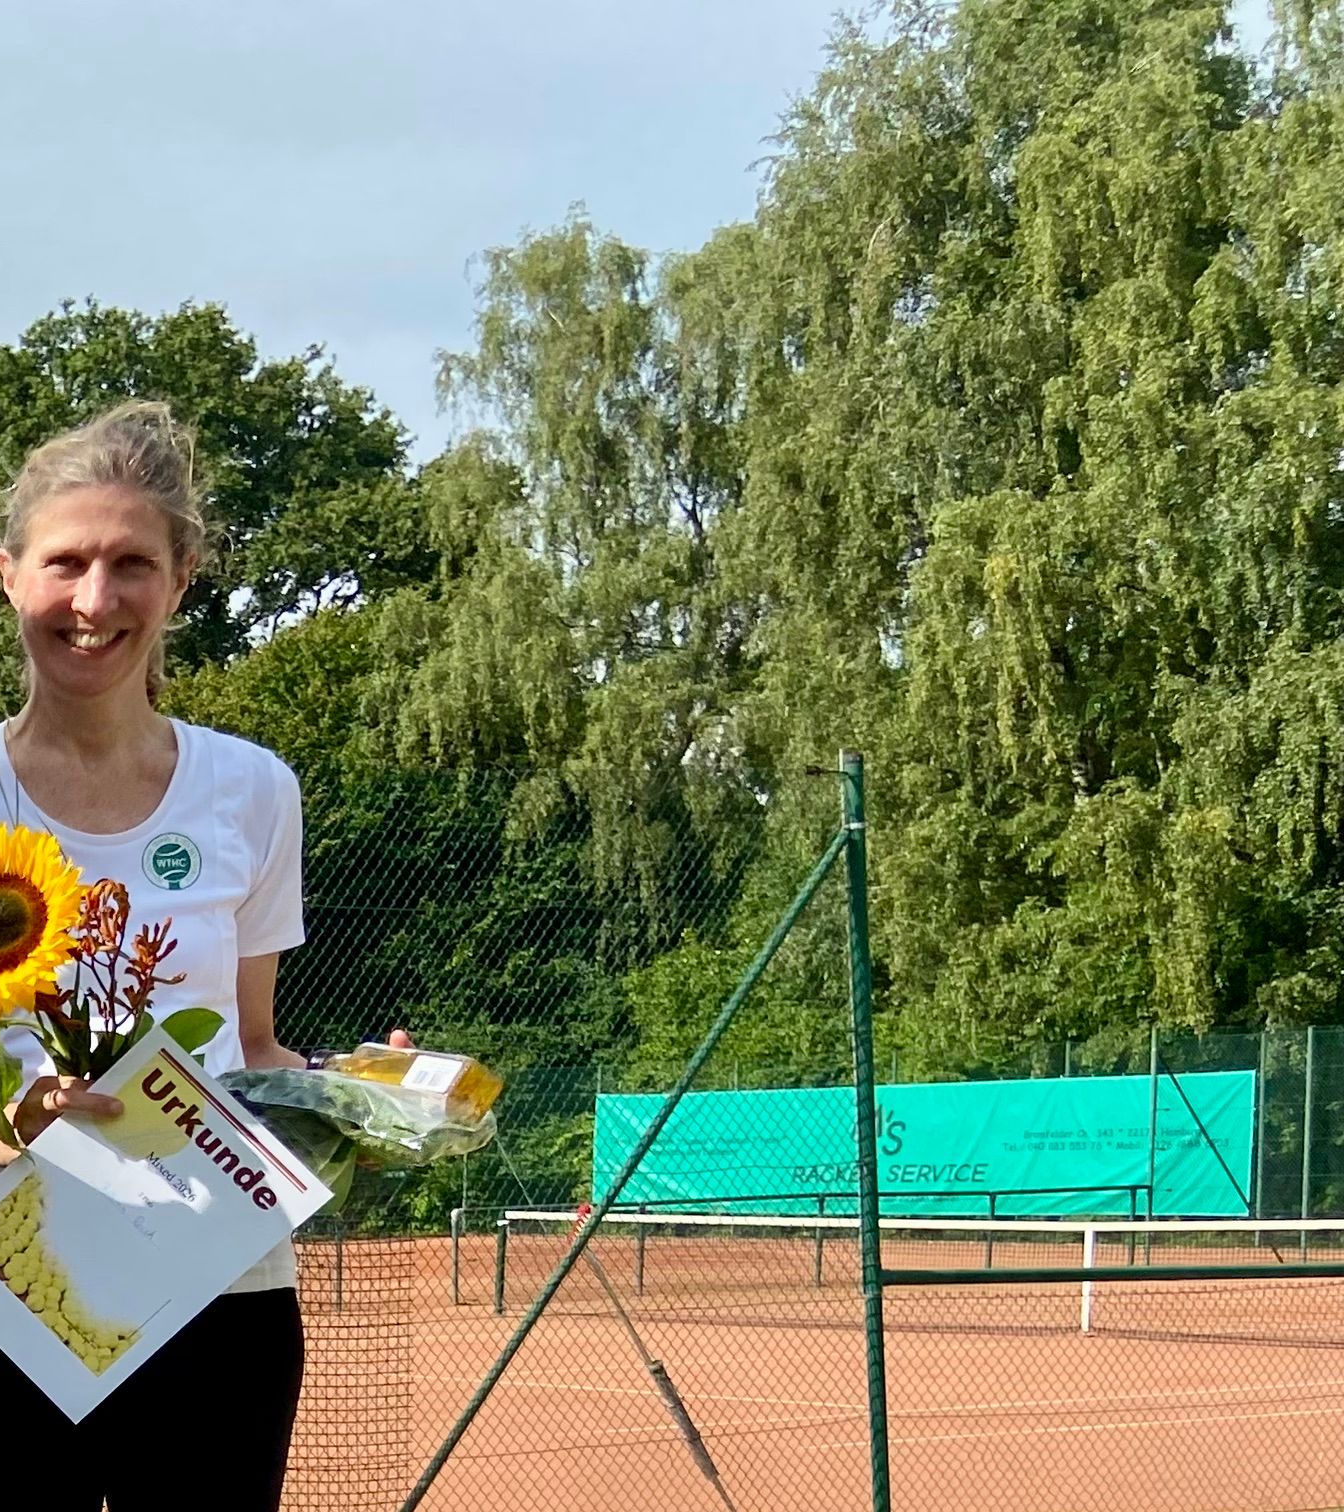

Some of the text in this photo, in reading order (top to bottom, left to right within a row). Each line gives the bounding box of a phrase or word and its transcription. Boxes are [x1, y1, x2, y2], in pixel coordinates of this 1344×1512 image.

[156, 857, 187, 868] WTHC
[141, 1068, 278, 1211] Urkunde
[146, 1151, 176, 1182] Mixed
[172, 1178, 197, 1203] 2026
[792, 1163, 989, 1185] RACKE SERVICE
